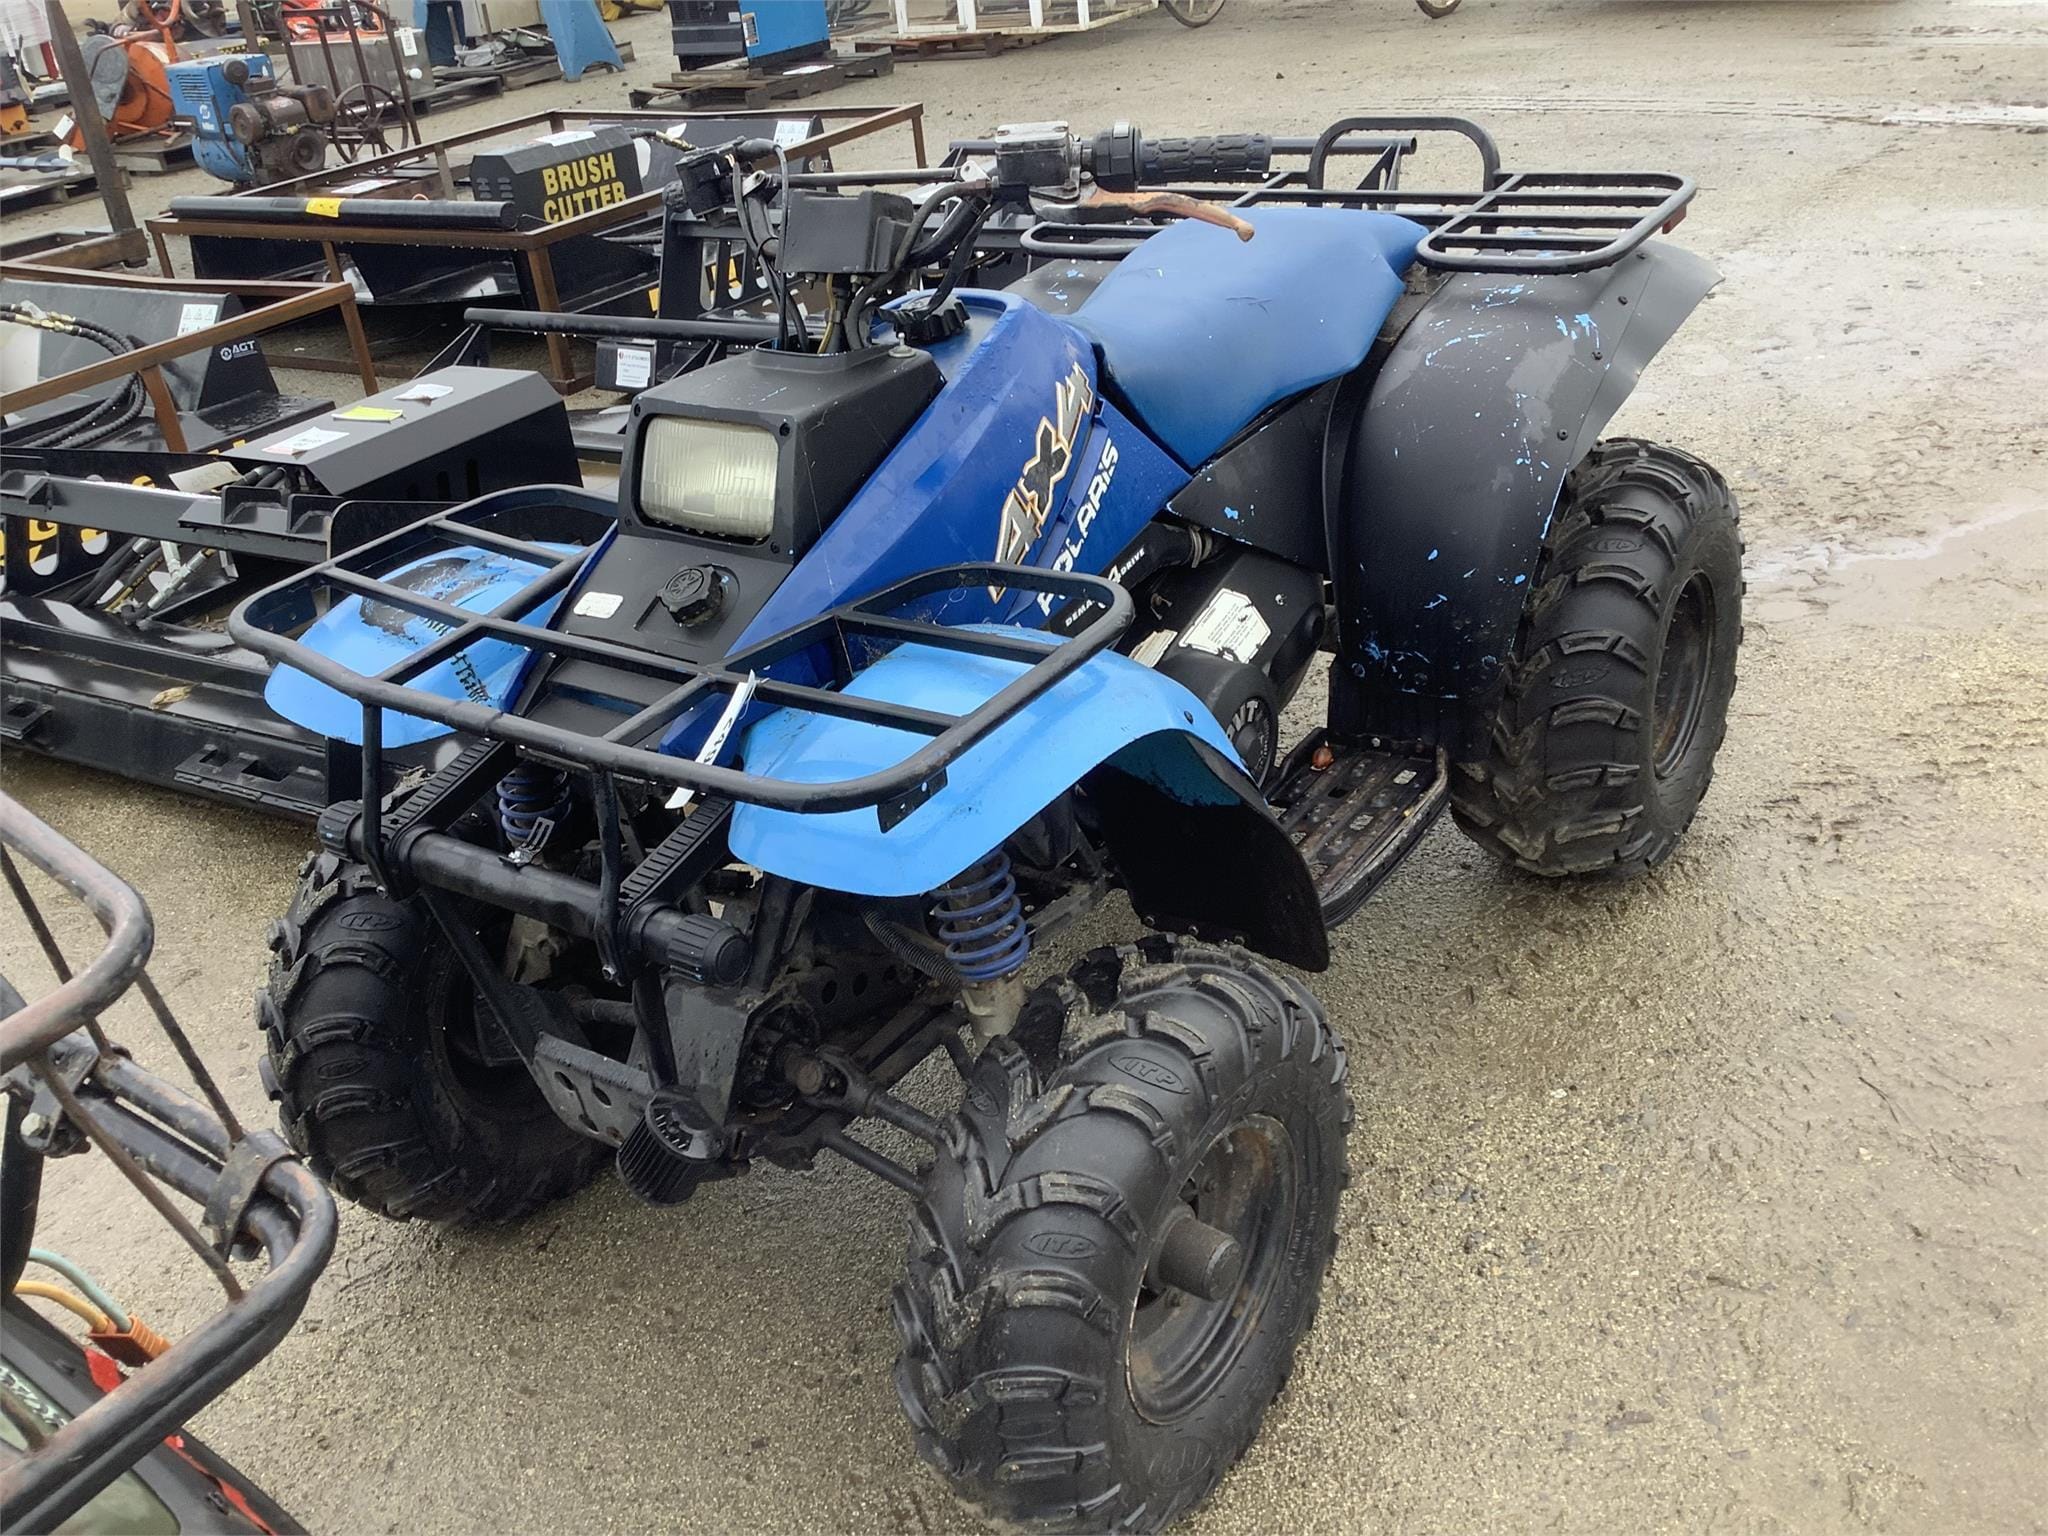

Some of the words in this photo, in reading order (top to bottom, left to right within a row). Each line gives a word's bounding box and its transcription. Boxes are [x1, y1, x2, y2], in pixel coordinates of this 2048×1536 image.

[542, 152, 617, 196] BRUSH
[543, 181, 627, 224] CUTTER
[232, 340, 255, 354] AGT
[1120, 547, 1146, 576] DRIVE
[1122, 1061, 1178, 1086] ITP
[1042, 1237, 1086, 1255] ITP
